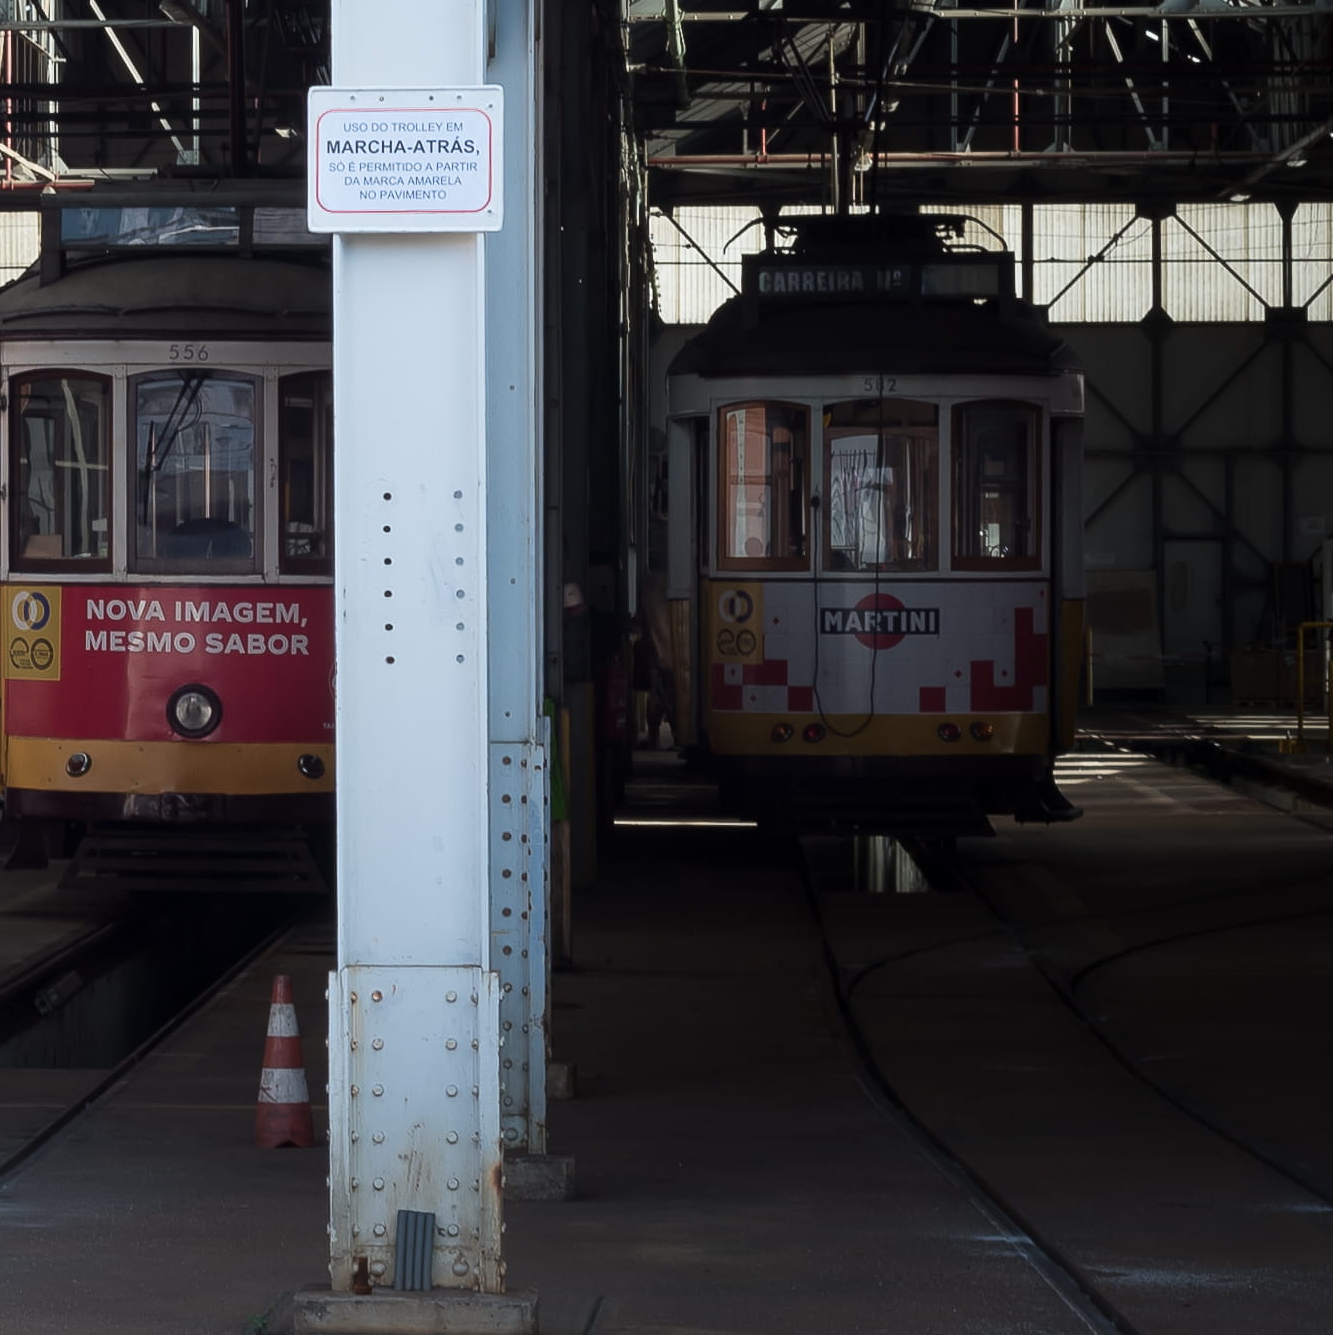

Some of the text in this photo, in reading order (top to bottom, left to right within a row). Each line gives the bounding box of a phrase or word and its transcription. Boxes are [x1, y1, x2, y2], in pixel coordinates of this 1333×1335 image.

[343, 121, 463, 132] USO DO TROLLEY EM
[326, 136, 480, 156] MARCHA-ATRÁS,
[329, 161, 478, 172] SÓ É PERMITIDO A PARTIR
[344, 176, 462, 186] DA MARCA AMARELA
[359, 190, 447, 200] NO PAVIMENTO
[758, 270, 864, 293] CARREIRA
[169, 344, 209, 361] 556
[86, 599, 308, 627] NOVA IMAGEM,
[824, 610, 937, 633] MARTINI
[85, 630, 309, 656] MESMO SABOR
